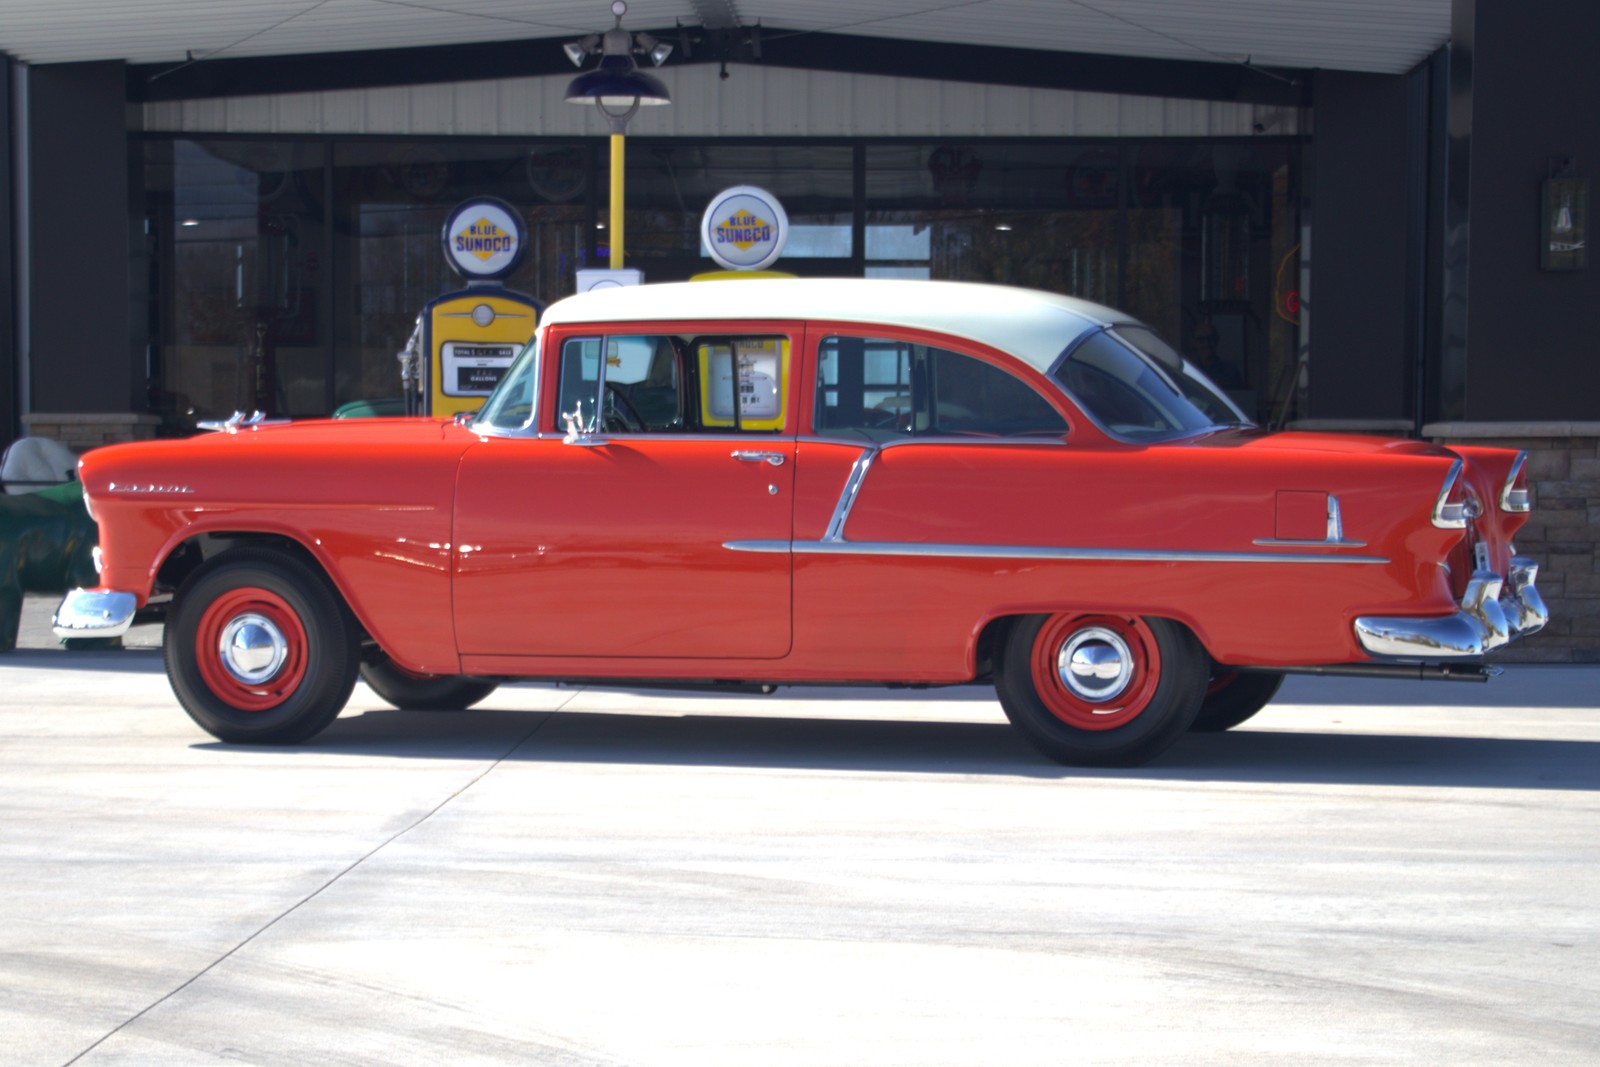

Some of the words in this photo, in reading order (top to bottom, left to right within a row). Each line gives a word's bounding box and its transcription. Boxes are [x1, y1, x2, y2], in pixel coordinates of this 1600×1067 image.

[729, 216, 757, 226] BLUE
[470, 225, 497, 235] BLUE
[717, 225, 770, 243] SUNOCO
[457, 236, 511, 252] SUNOCO
